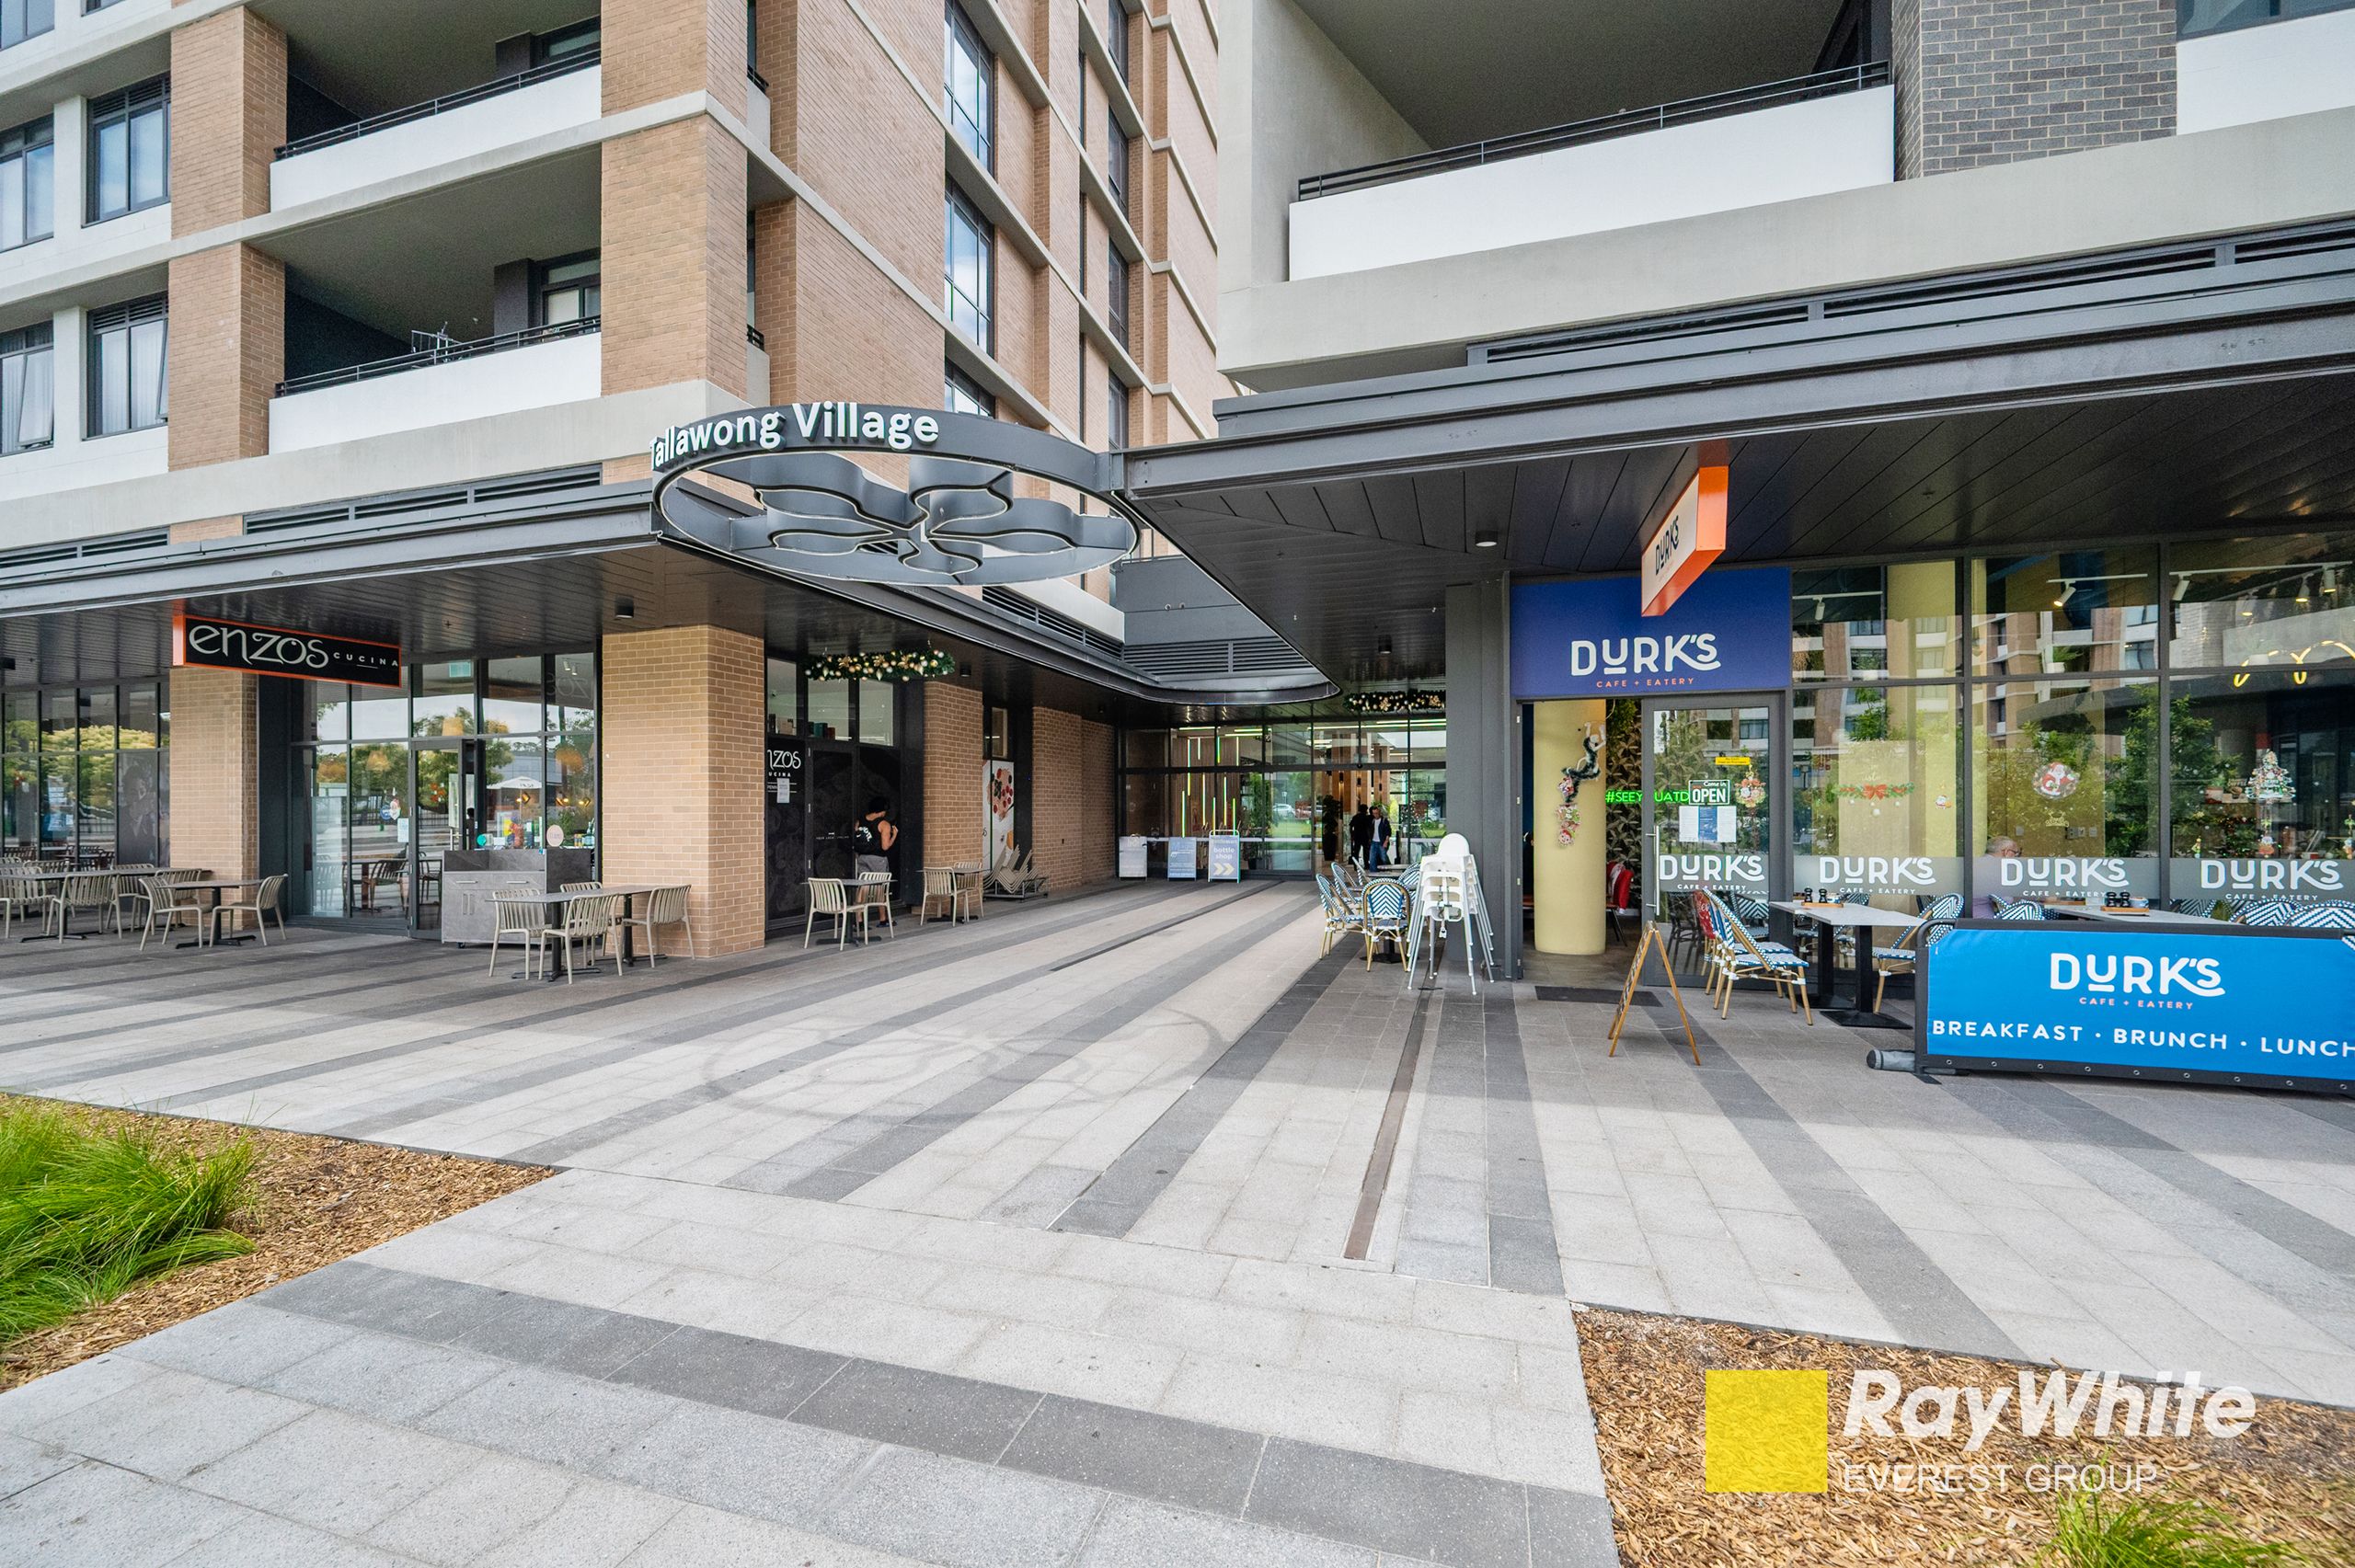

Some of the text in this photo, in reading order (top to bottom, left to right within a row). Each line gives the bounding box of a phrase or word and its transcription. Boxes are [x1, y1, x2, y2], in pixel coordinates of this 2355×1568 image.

[649, 401, 939, 471] Tallawong Village
[333, 651, 399, 667] CUCINA
[1571, 633, 1722, 676] DURK'S
[1596, 680, 1627, 688] CAFE
[1647, 677, 1694, 687] EATERY
[1692, 788, 1727, 803] OPEN
[1659, 855, 1765, 882] DURK'S
[1819, 856, 1936, 885] DURK'S
[2001, 858, 2130, 888] DURK'S
[2200, 860, 2344, 890] DURK'S
[2050, 952, 2226, 997] DURK'S
[2080, 997, 2116, 1007] CAFE
[2138, 999, 2194, 1010] EATERY
[1933, 1019, 2355, 1059] BREAKFAST BRUNCH LUNCH
